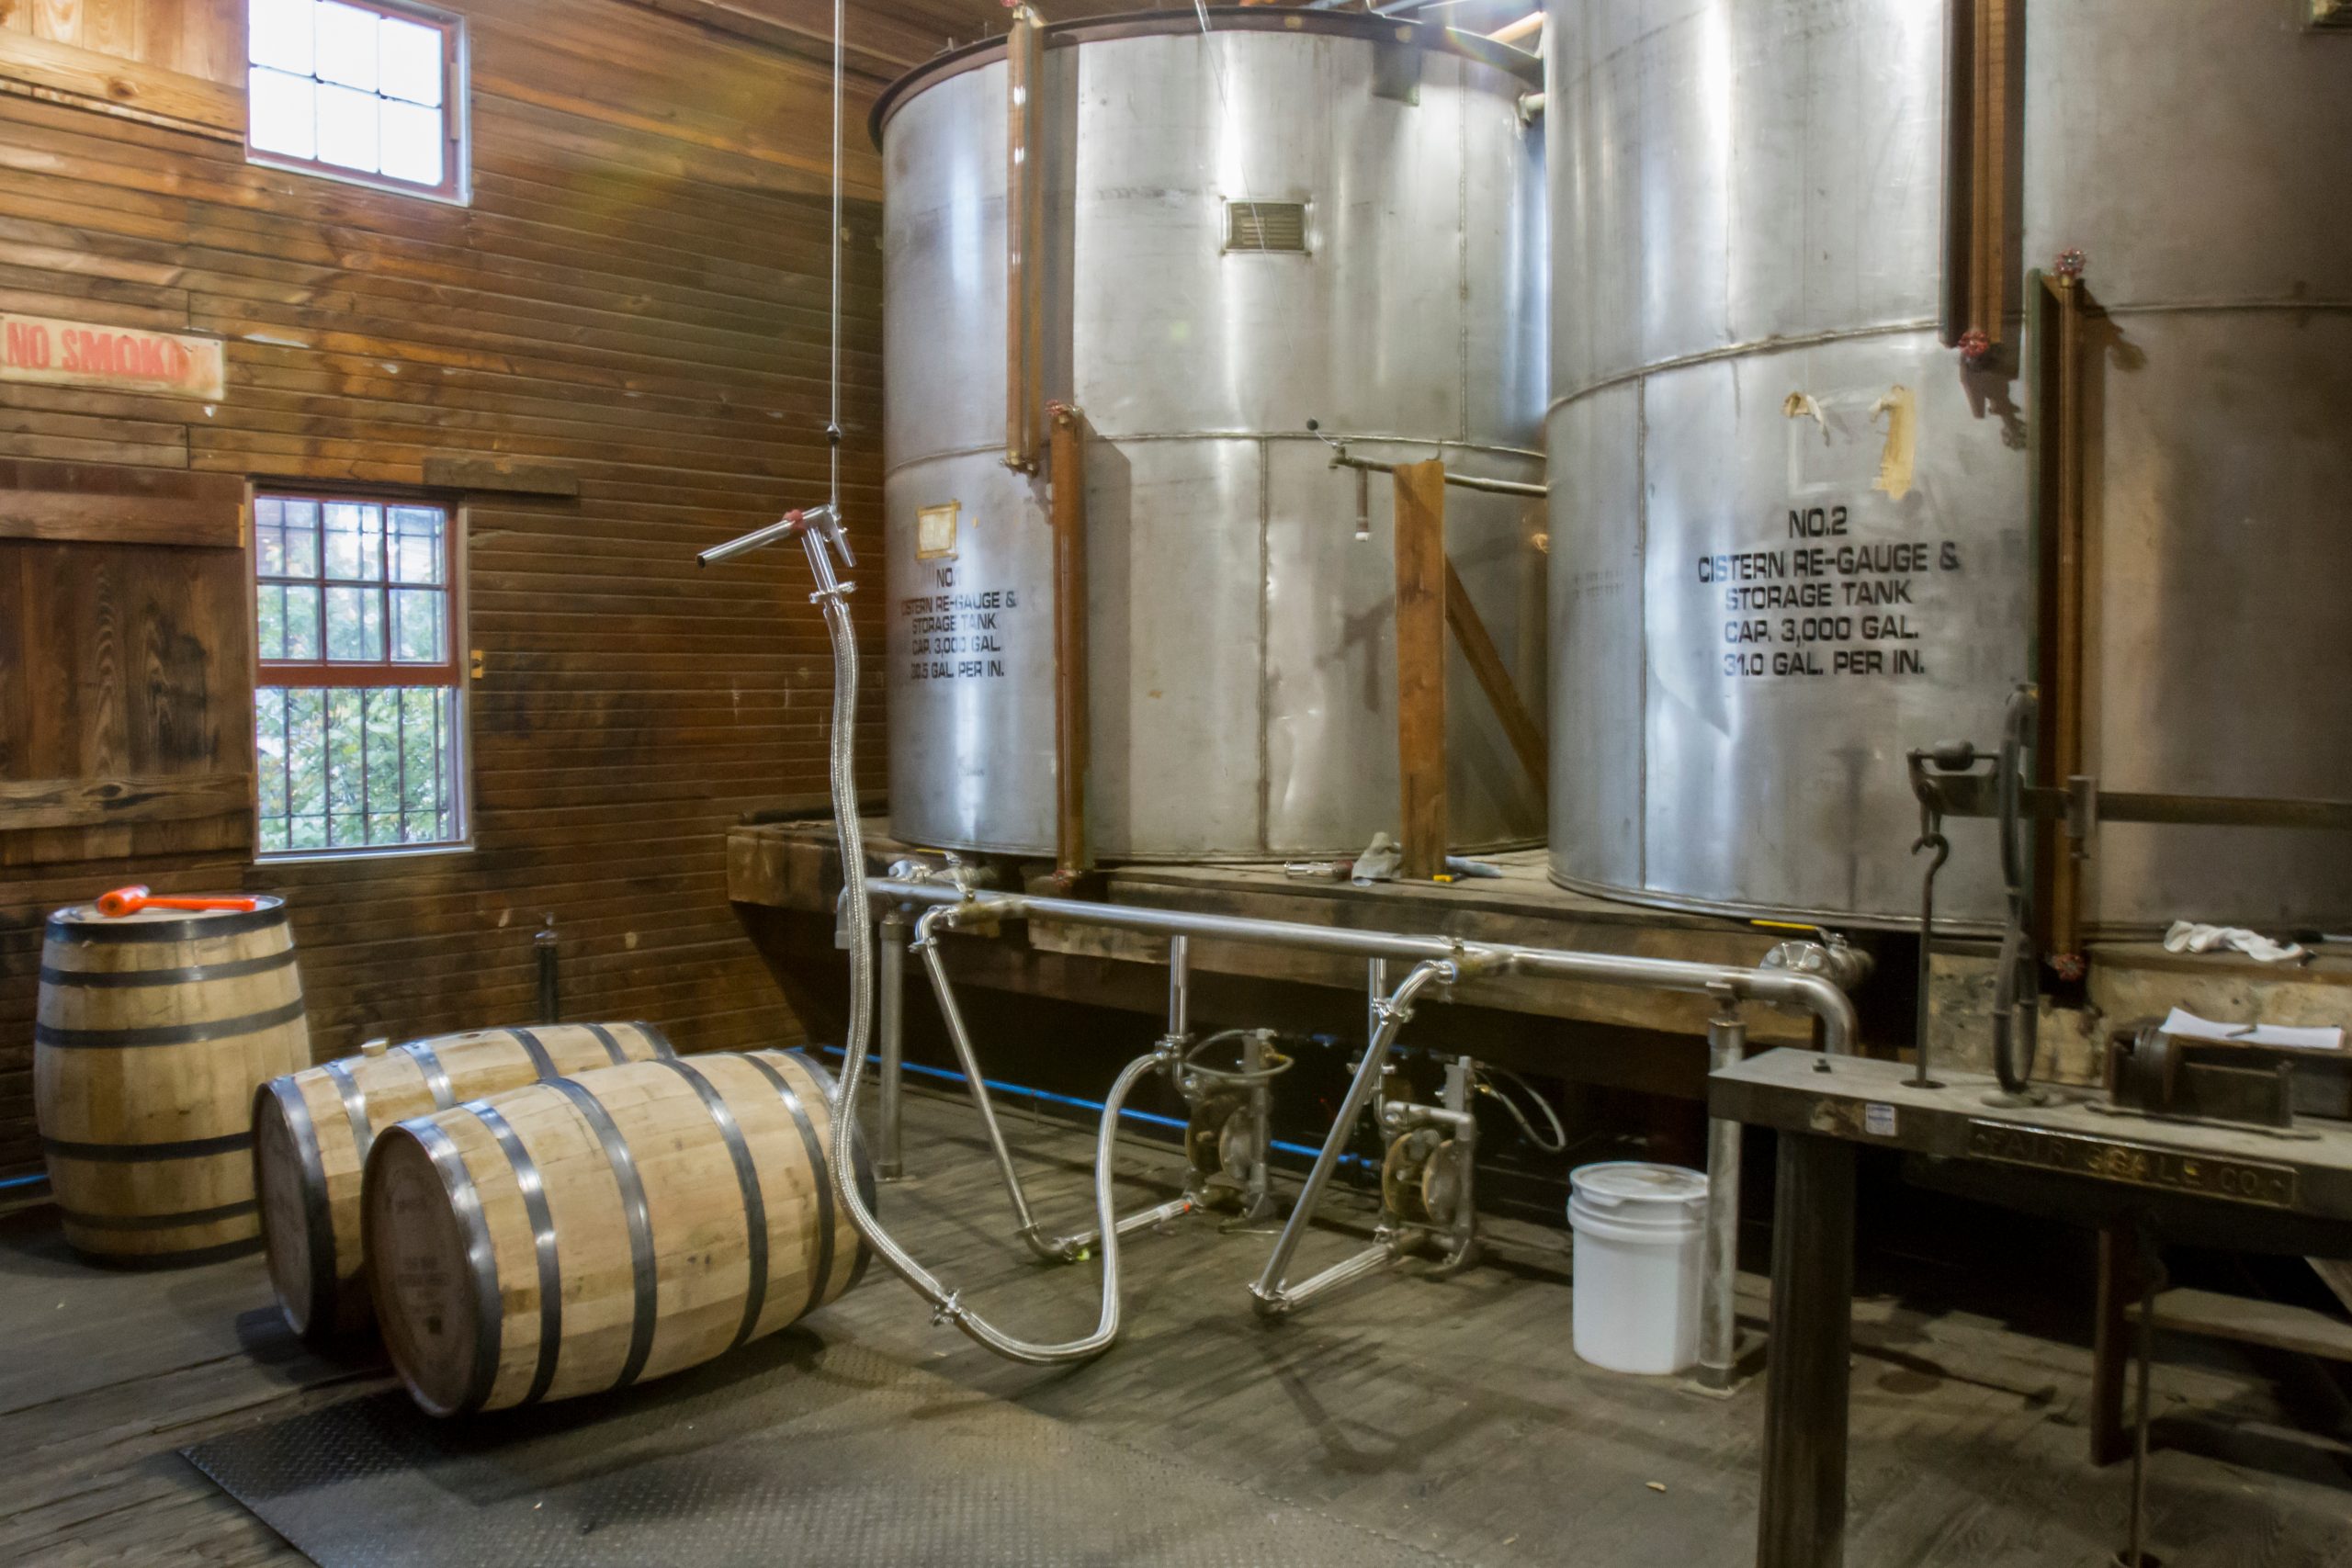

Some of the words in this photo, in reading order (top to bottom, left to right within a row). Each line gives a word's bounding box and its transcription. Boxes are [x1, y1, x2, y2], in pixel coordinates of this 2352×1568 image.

[6, 321, 51, 371] NO
[1788, 505, 1849, 539] NO.2
[1698, 550, 1785, 583] CISTERN
[1792, 542, 1928, 578] RE-GAUGE
[1939, 541, 1961, 571] &
[1005, 591, 1017, 608] &
[1724, 582, 1833, 612] STORAGE
[1840, 579, 1914, 606] TANK
[912, 615, 956, 634] STORAGE
[961, 613, 997, 630] TANK
[1780, 615, 1852, 649] 3,000
[1860, 615, 1920, 640] GAL.
[958, 660, 982, 678] PER
[988, 660, 1004, 677] IN.
[1771, 651, 1825, 677] GAL.
[1833, 649, 1883, 676] PER
[1893, 649, 1926, 675] IN.
